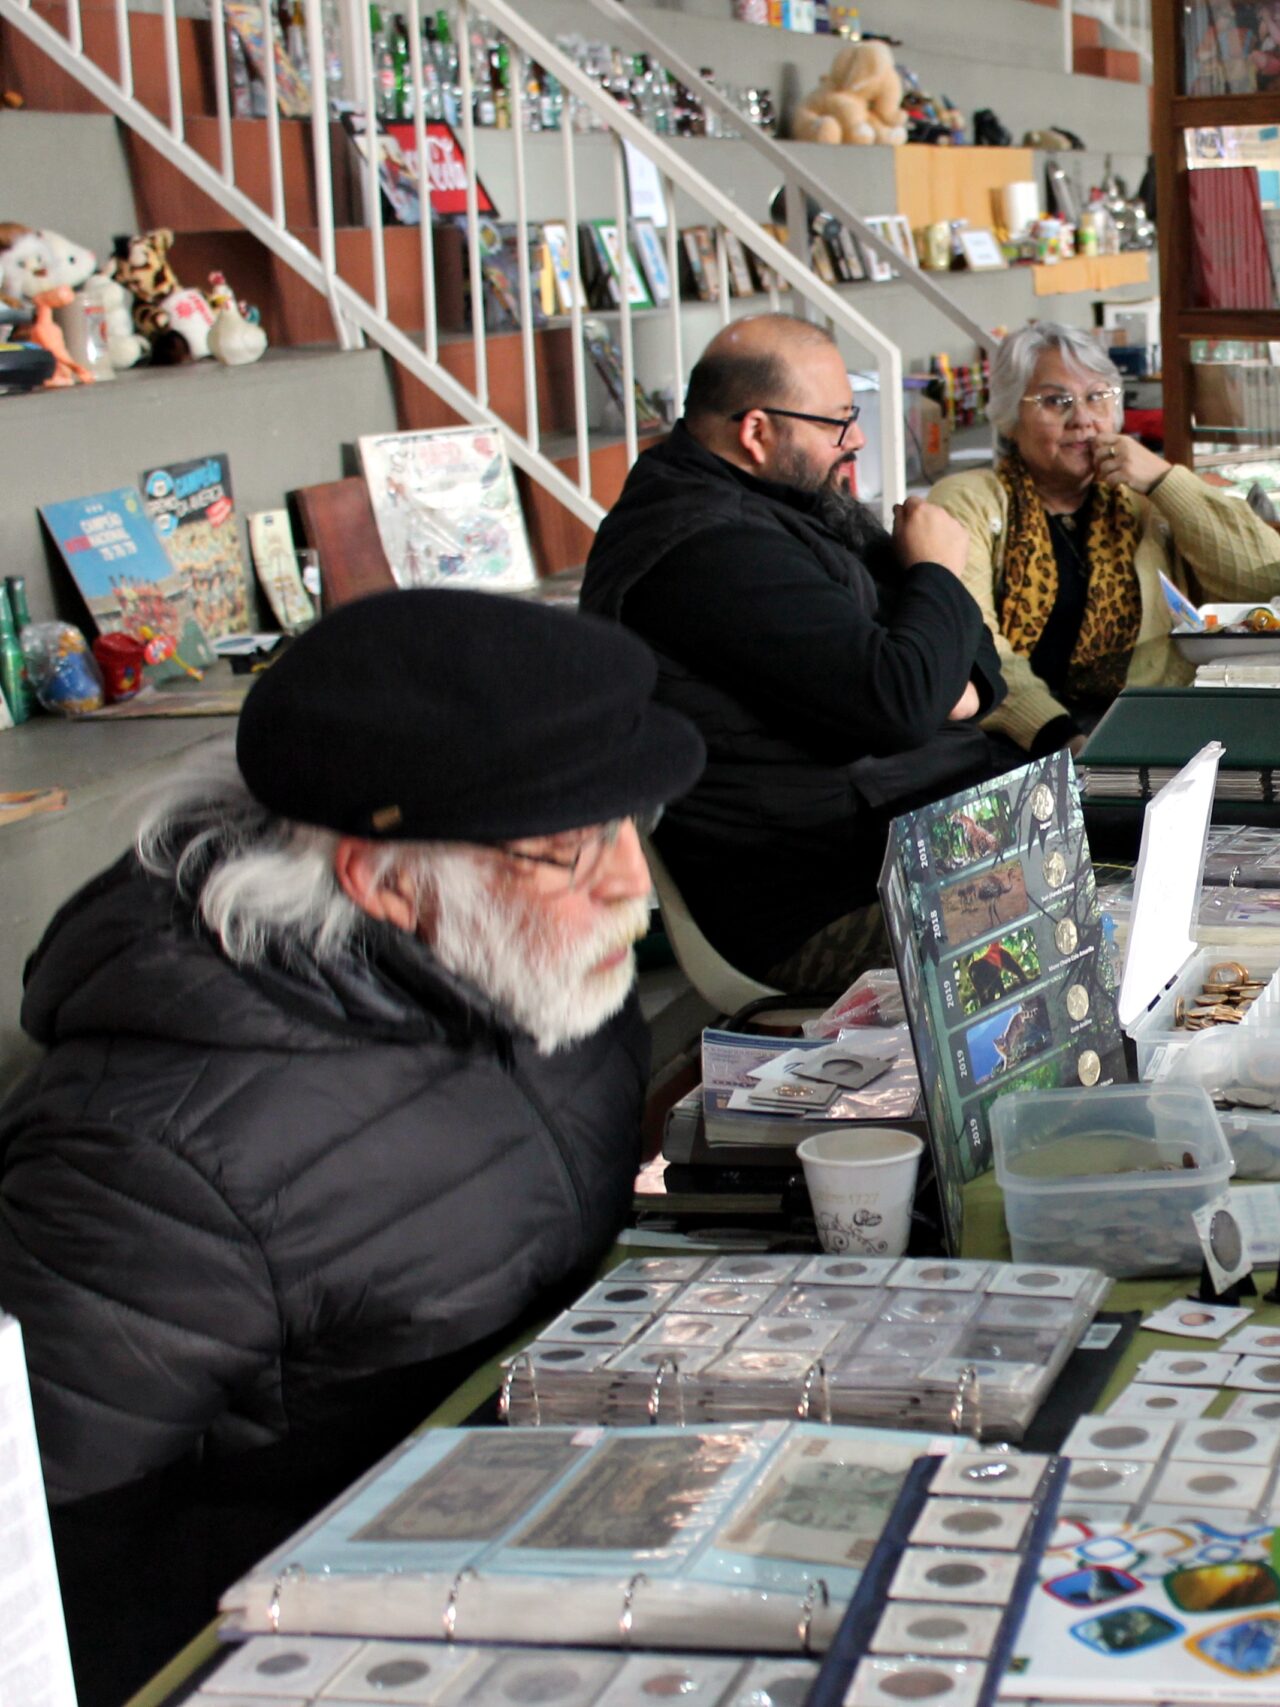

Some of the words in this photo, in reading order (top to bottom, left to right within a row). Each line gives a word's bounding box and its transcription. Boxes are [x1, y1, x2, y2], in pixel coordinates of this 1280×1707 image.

[916, 839, 928, 869] 2018
[930, 909, 942, 940] 2018
[943, 980, 955, 1009] 2019
[956, 1049, 968, 1078] 2019
[969, 1117, 981, 1146] 2019
